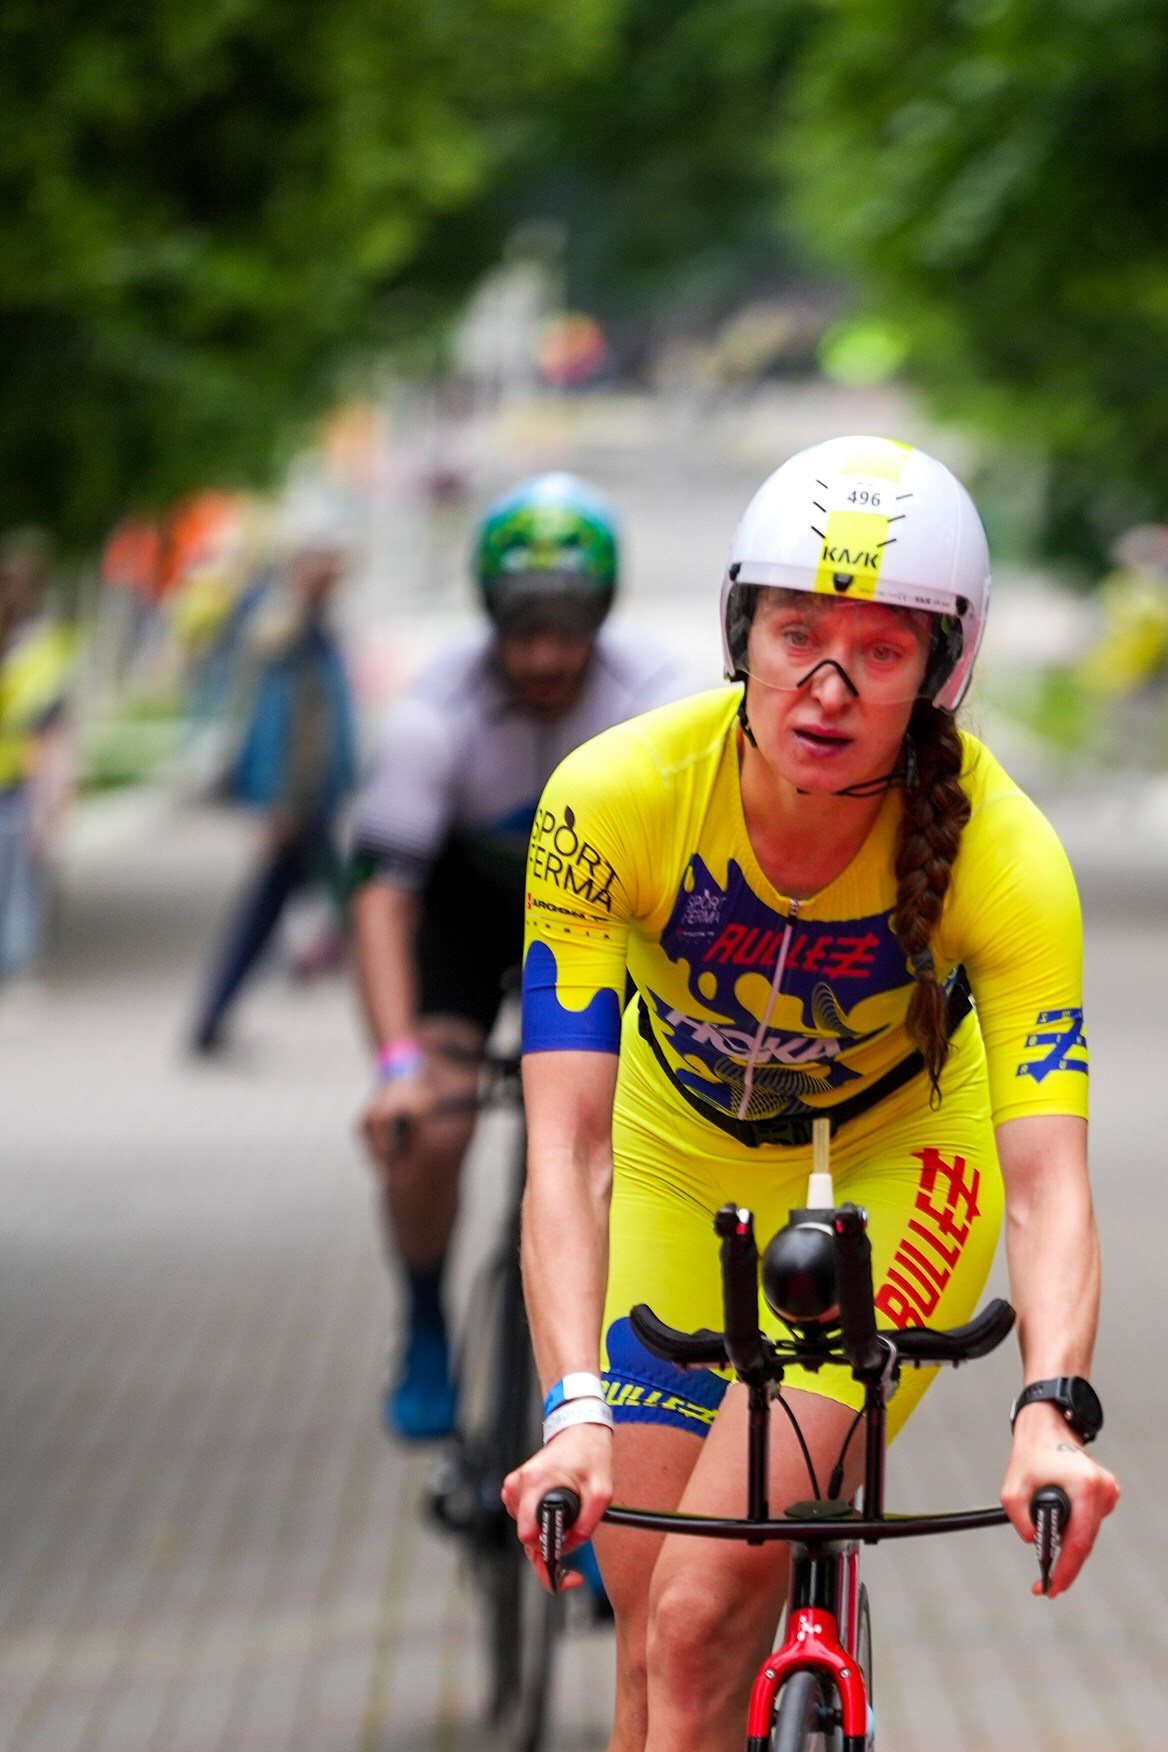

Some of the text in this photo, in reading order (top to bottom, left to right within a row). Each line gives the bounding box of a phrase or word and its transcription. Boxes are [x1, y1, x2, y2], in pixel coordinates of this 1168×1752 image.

[847, 490, 881, 507] 496
[822, 546, 879, 569] KASK
[664, 1007, 841, 1064] HOKA
